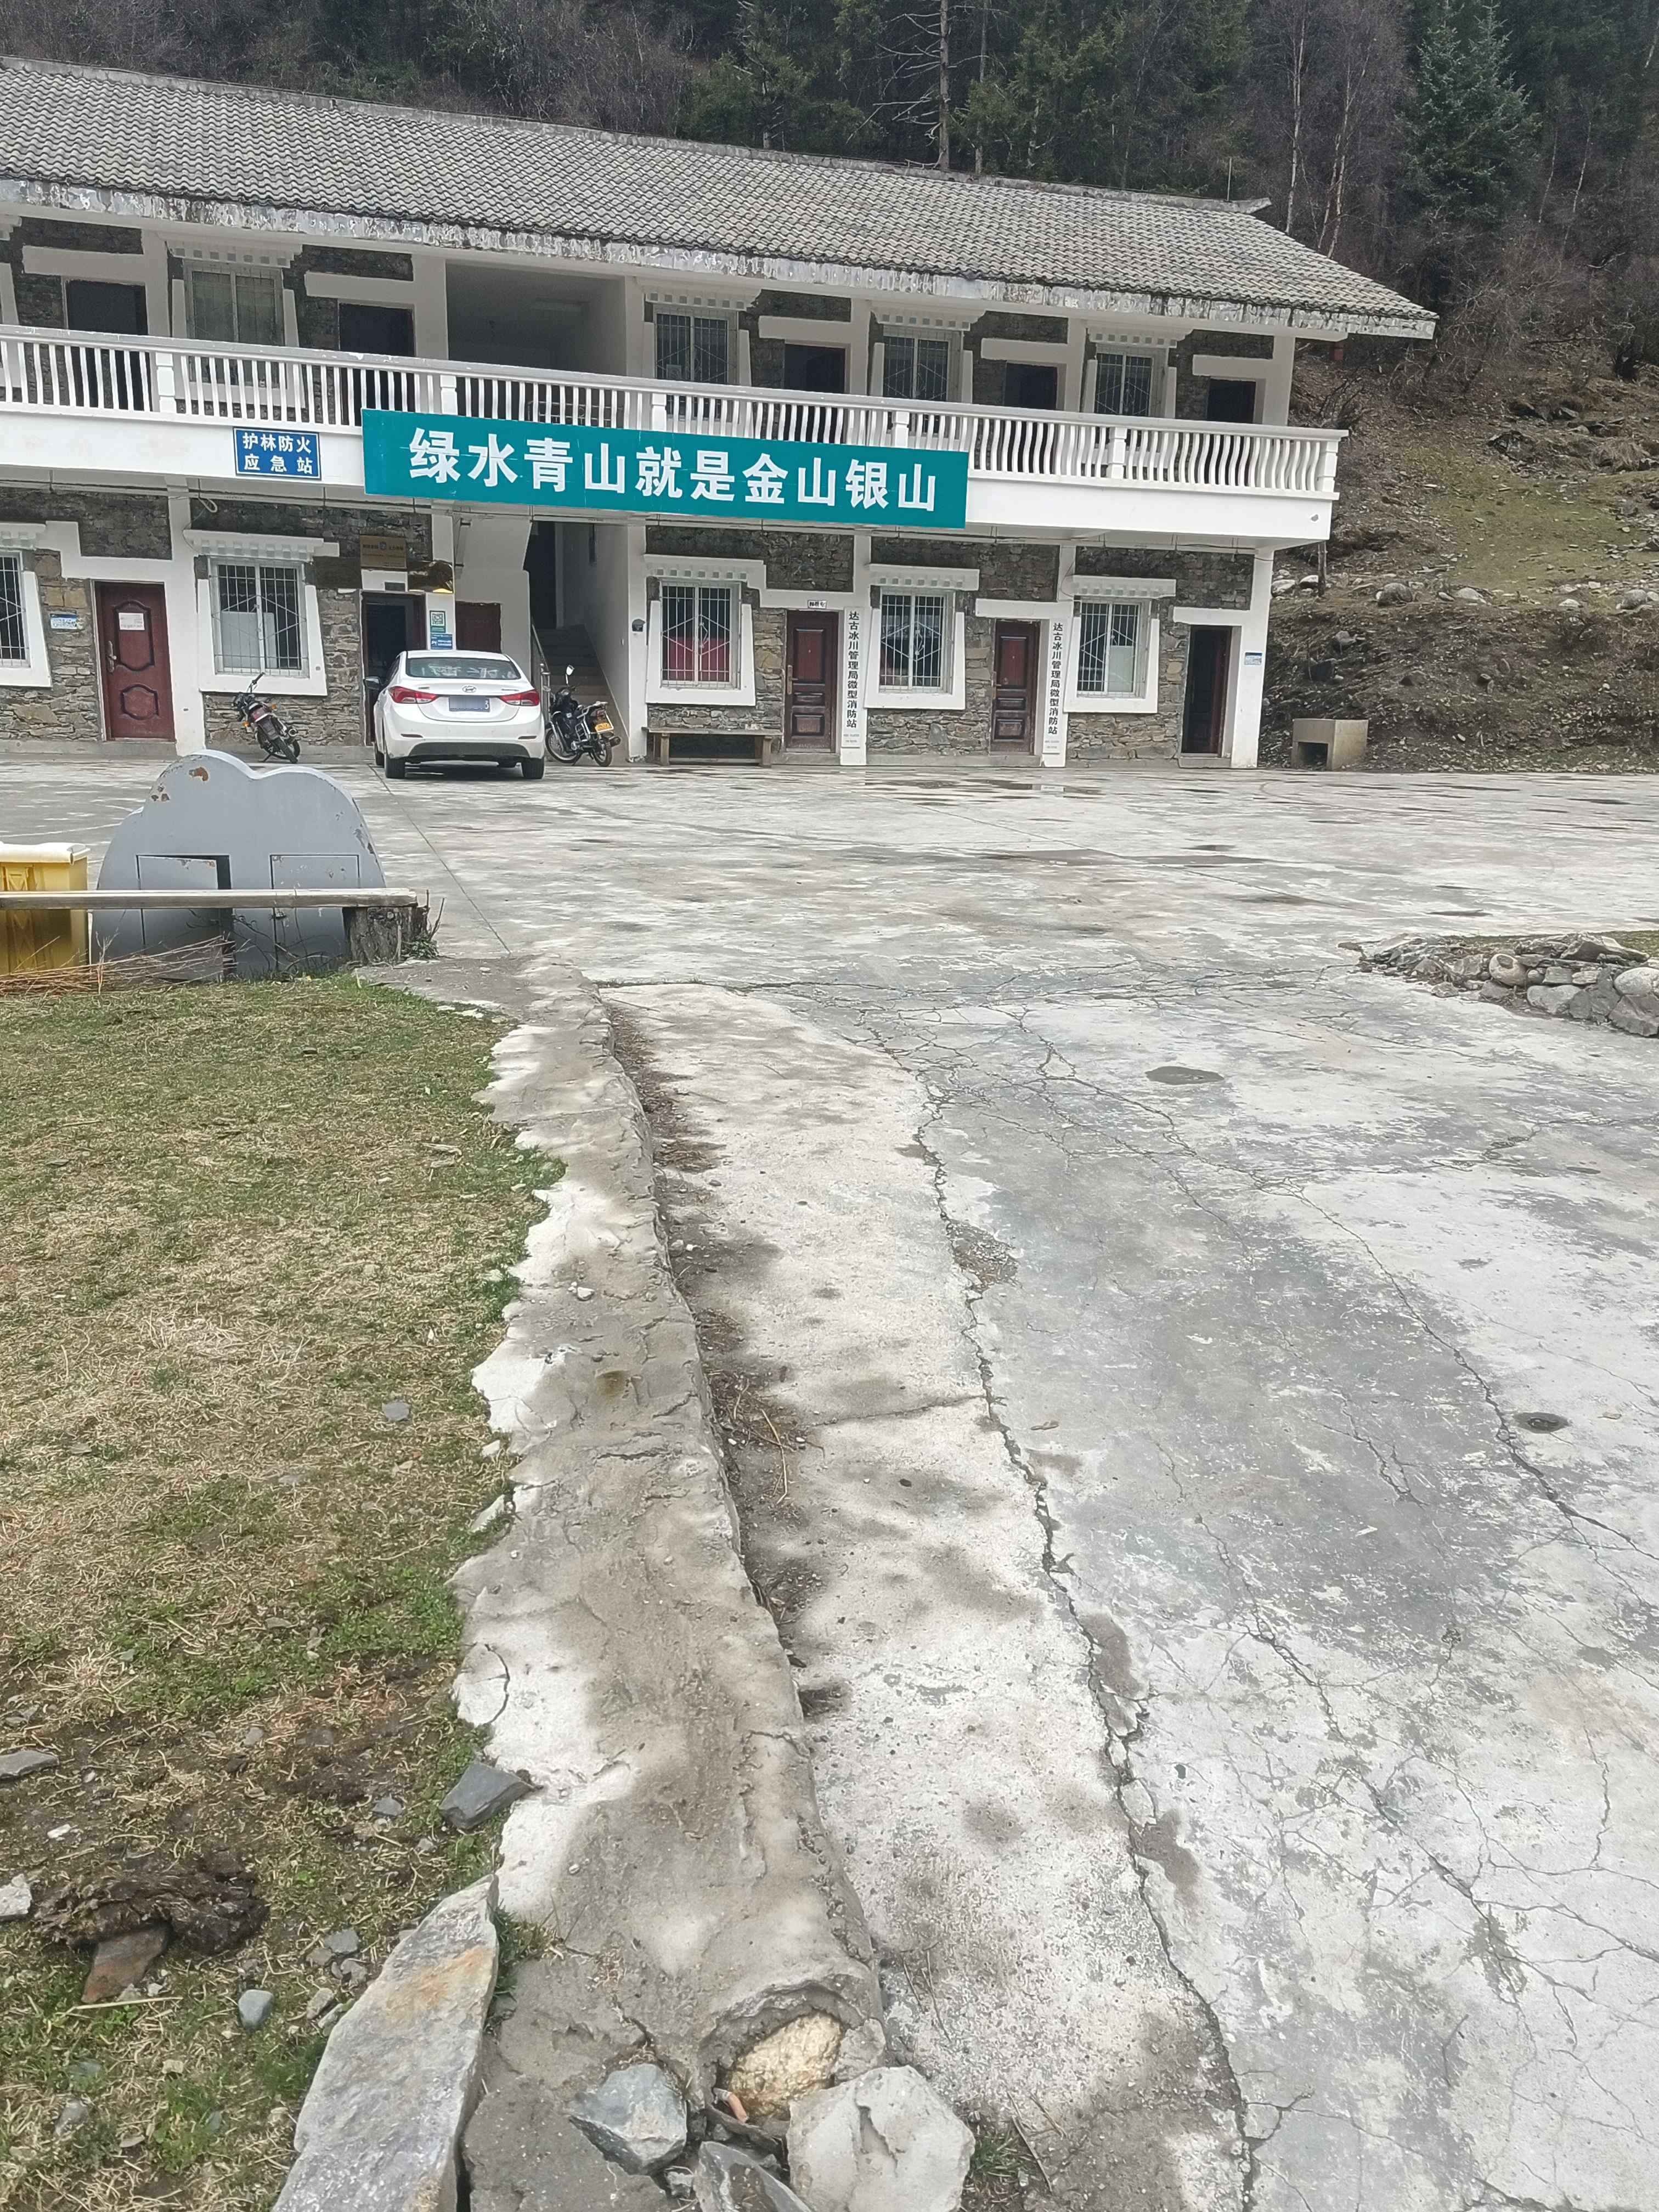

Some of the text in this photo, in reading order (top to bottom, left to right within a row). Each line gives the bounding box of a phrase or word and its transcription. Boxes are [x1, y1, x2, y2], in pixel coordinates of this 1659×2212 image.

[242, 432, 312, 454] 护林防火
[244, 453, 313, 475] 应急站
[408, 427, 936, 512] 绿水青山就是金山银山
[847, 611, 860, 728] 达古冰川管理局微型消防站
[1048, 623, 1063, 735] 达古冰川管理局微型消防站
